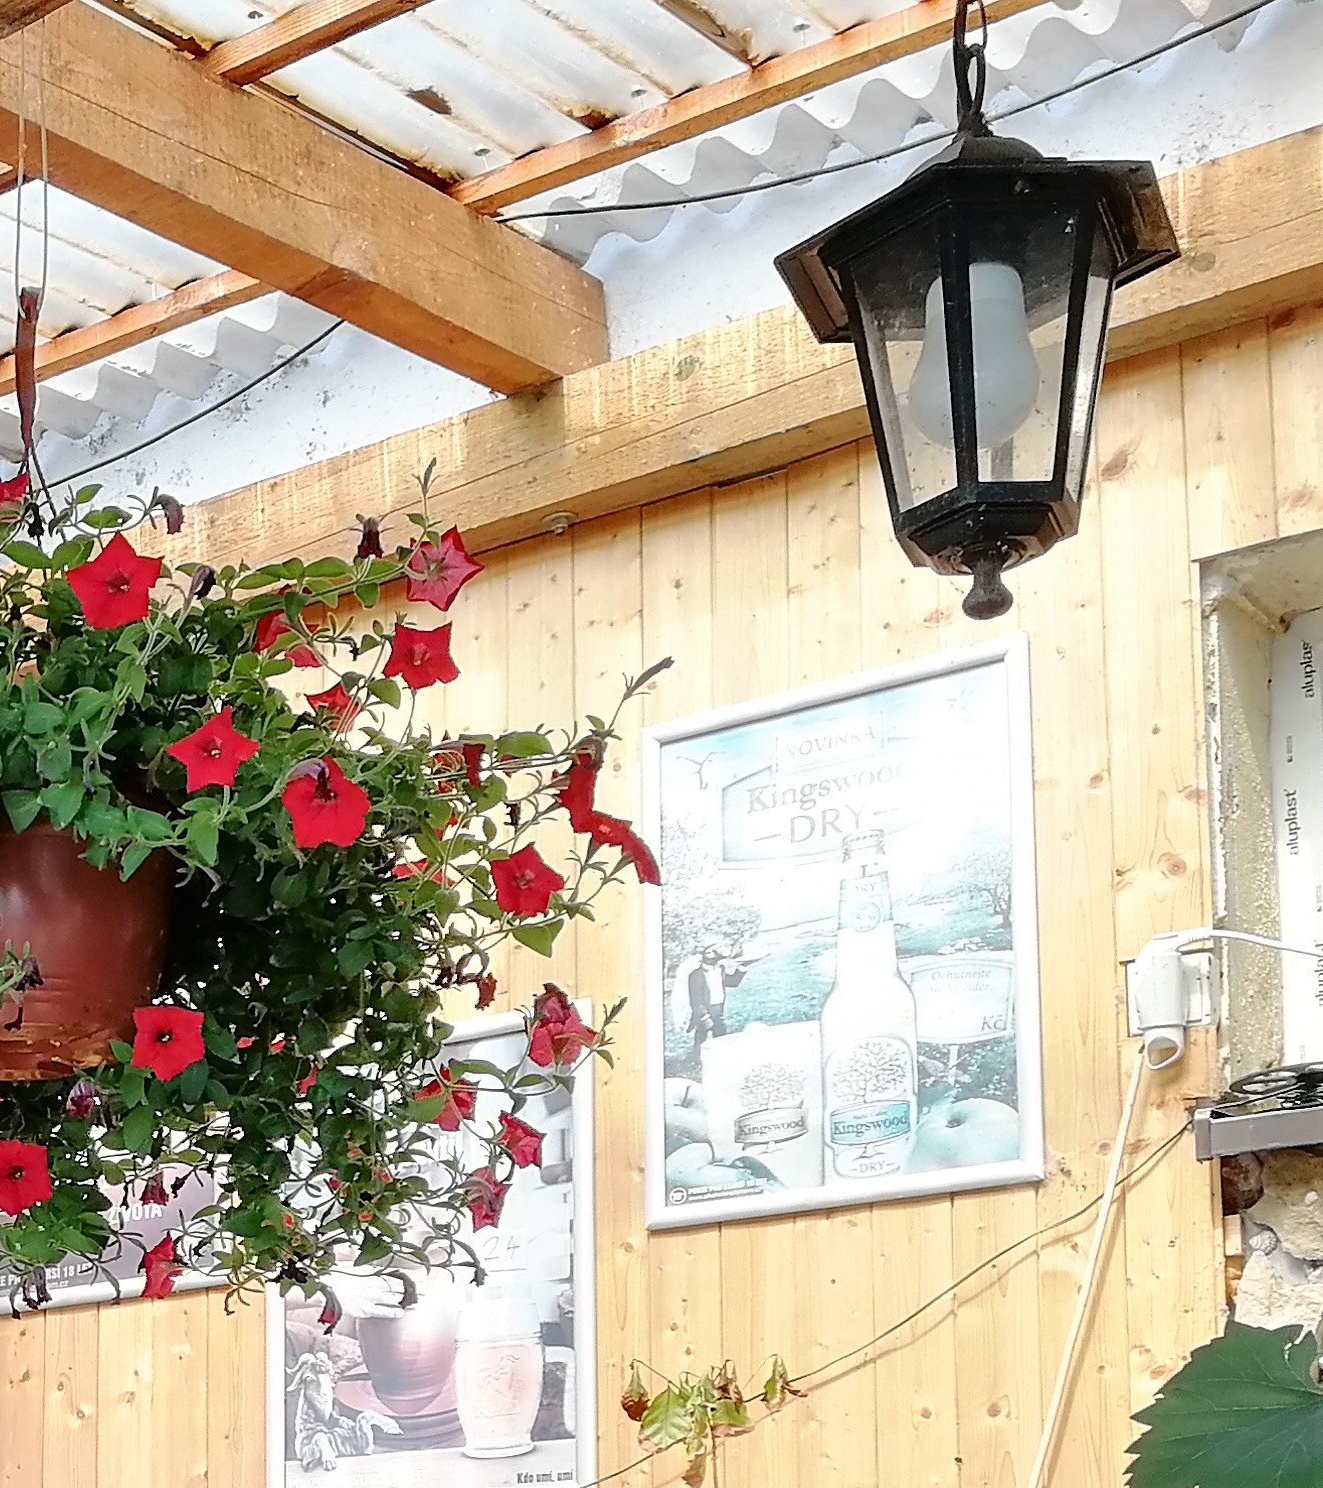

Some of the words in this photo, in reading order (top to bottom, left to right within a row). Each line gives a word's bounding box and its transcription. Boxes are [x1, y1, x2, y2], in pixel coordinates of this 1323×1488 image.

[790, 803, 868, 843] DRY
[739, 1116, 805, 1136] Kingswood
[833, 1115, 908, 1137] Kingswood
[859, 1160, 885, 1174] DRY
